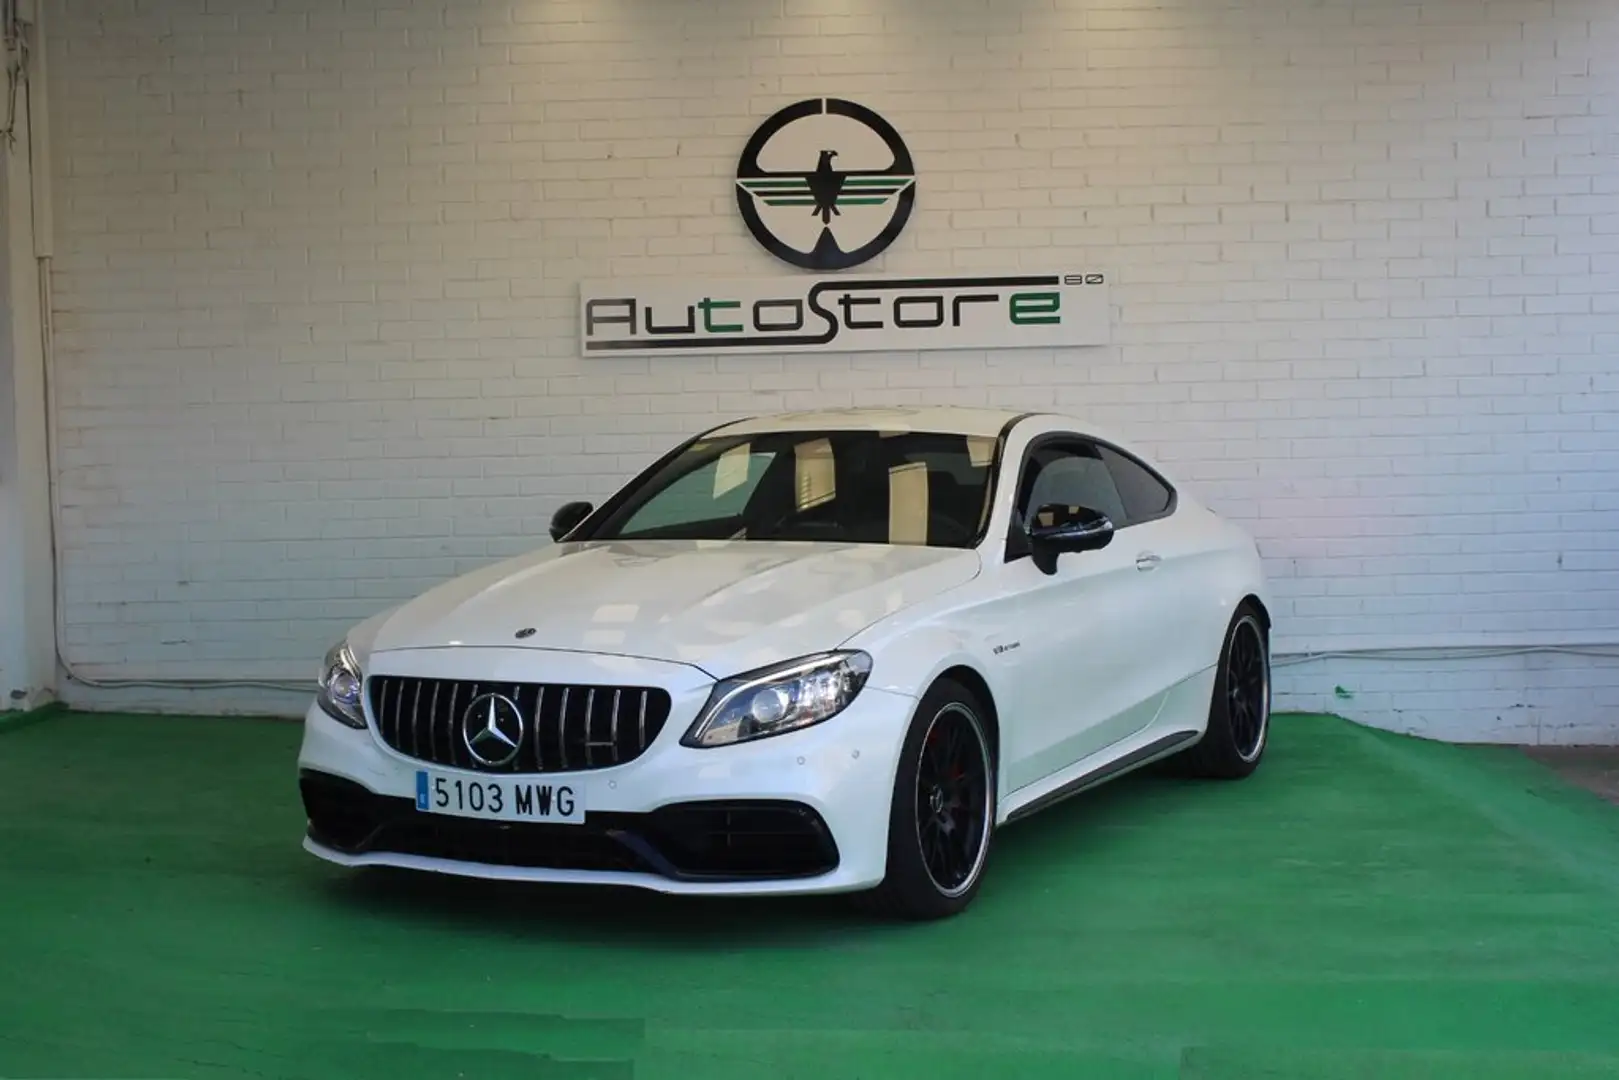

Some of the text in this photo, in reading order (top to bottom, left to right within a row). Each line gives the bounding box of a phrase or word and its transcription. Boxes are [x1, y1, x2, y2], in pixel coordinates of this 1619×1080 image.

[586, 274, 1104, 350] AutoStore 80
[435, 778, 575, 816] 5103 MWG
